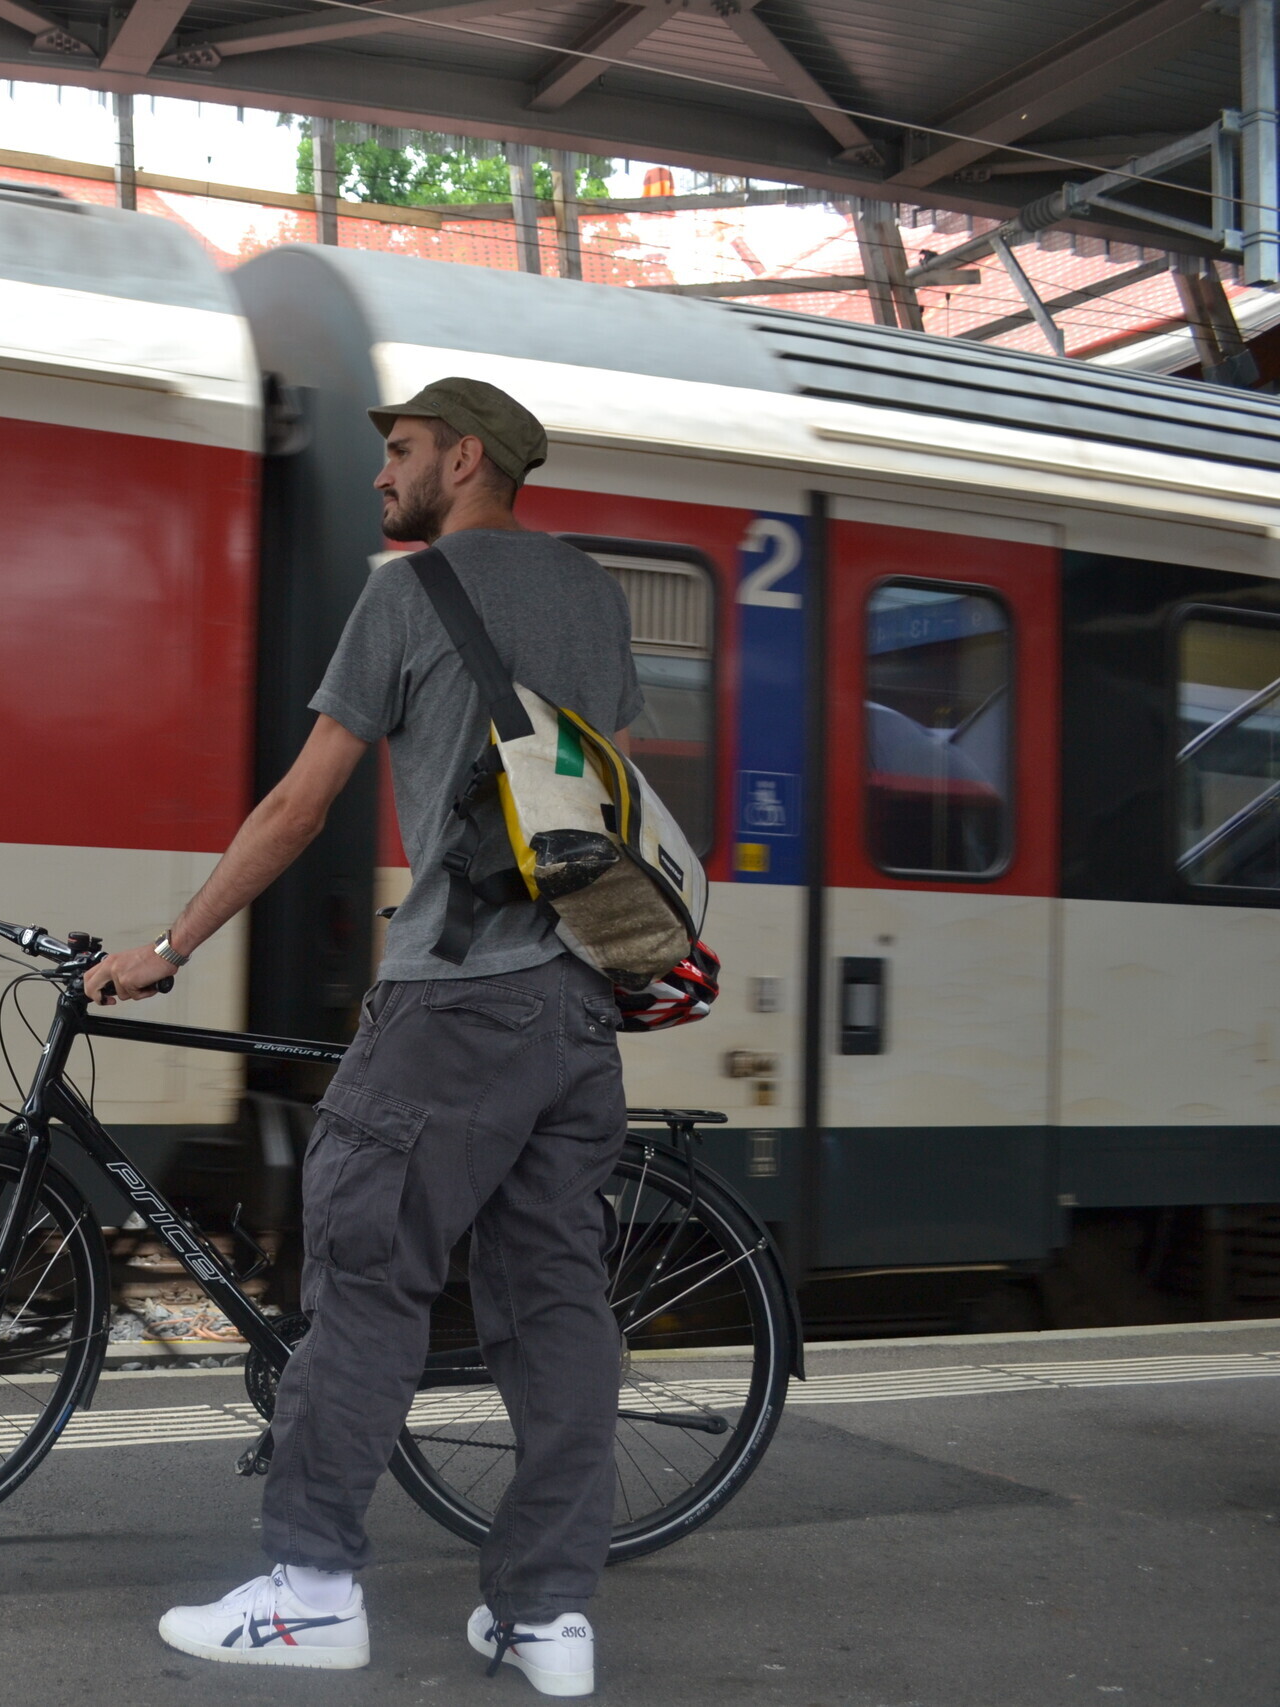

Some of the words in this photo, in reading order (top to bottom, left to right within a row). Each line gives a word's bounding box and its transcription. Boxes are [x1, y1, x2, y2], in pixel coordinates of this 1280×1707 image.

[735, 517, 803, 609] 2
[254, 1042, 322, 1057] adventure
[561, 1626, 587, 1638] asics
